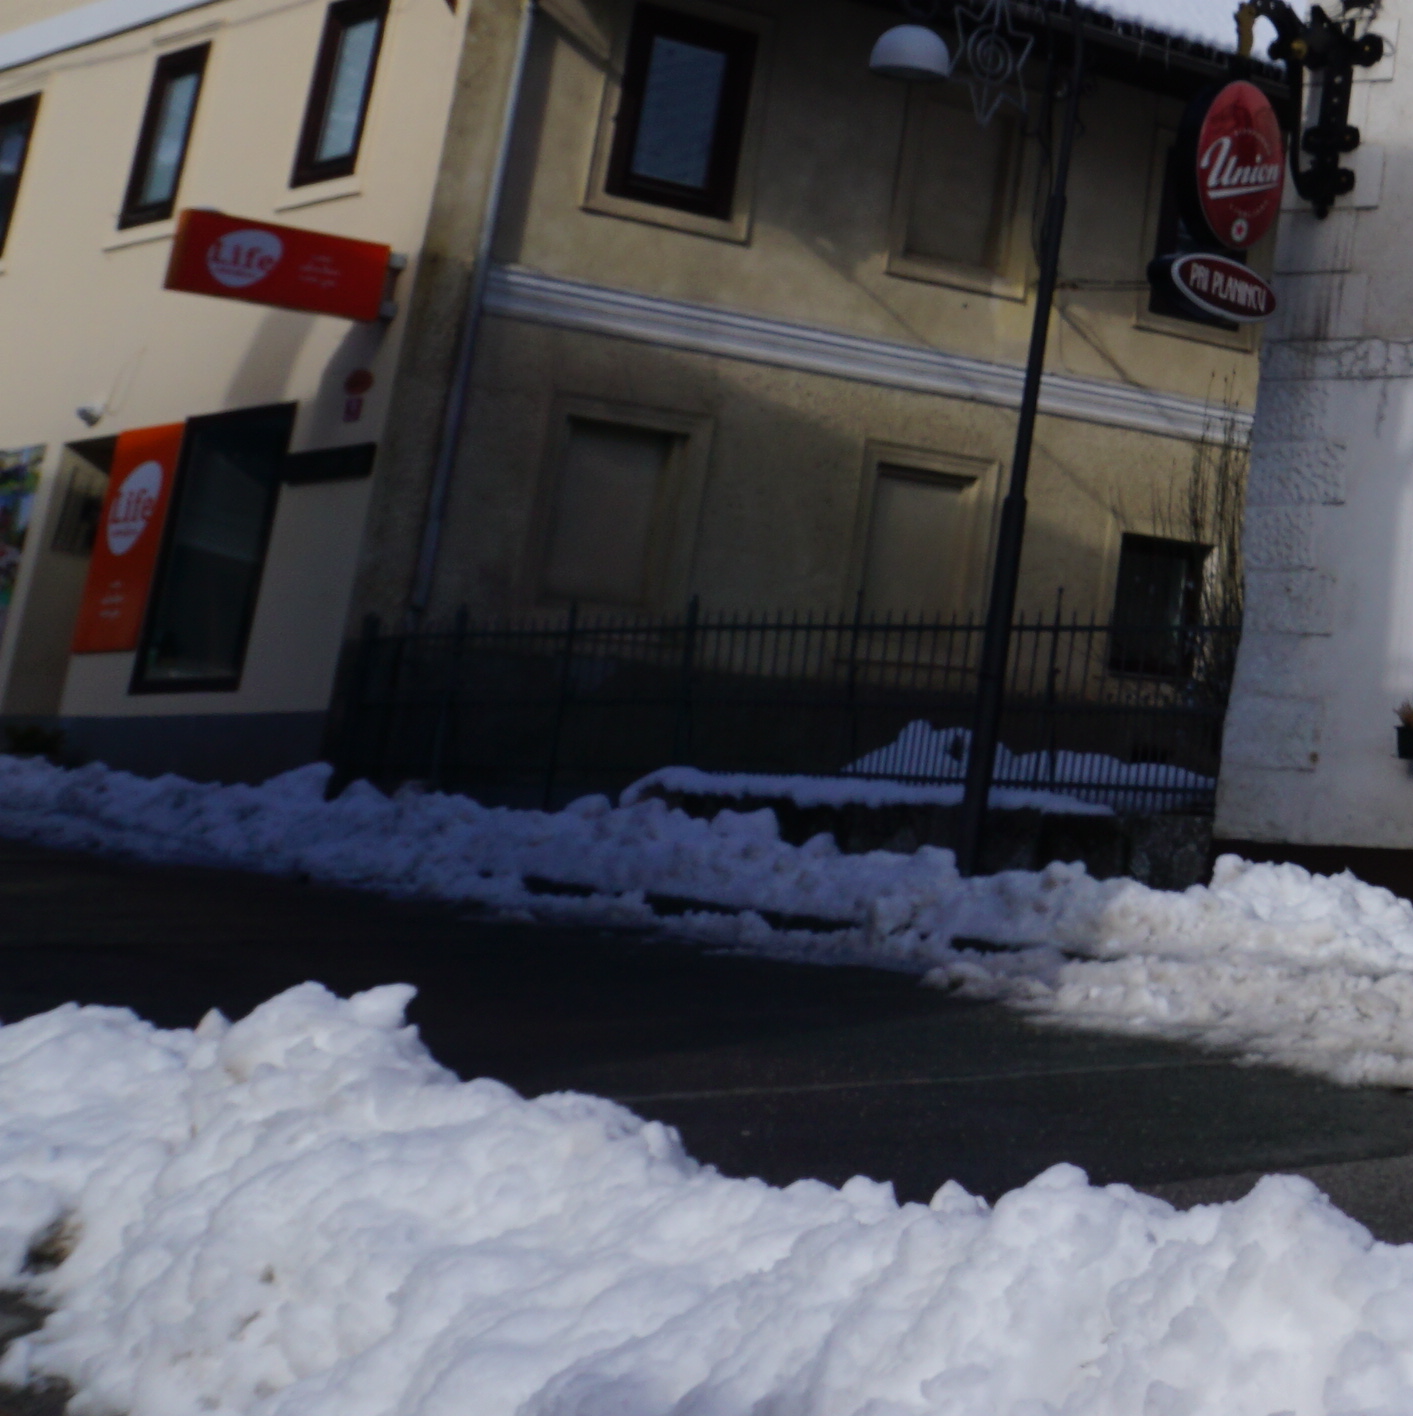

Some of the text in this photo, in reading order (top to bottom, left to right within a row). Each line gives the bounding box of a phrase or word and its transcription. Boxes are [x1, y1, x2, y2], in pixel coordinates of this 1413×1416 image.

[1200, 136, 1280, 188] Union
[210, 238, 275, 271] Life
[109, 488, 156, 523] Life
